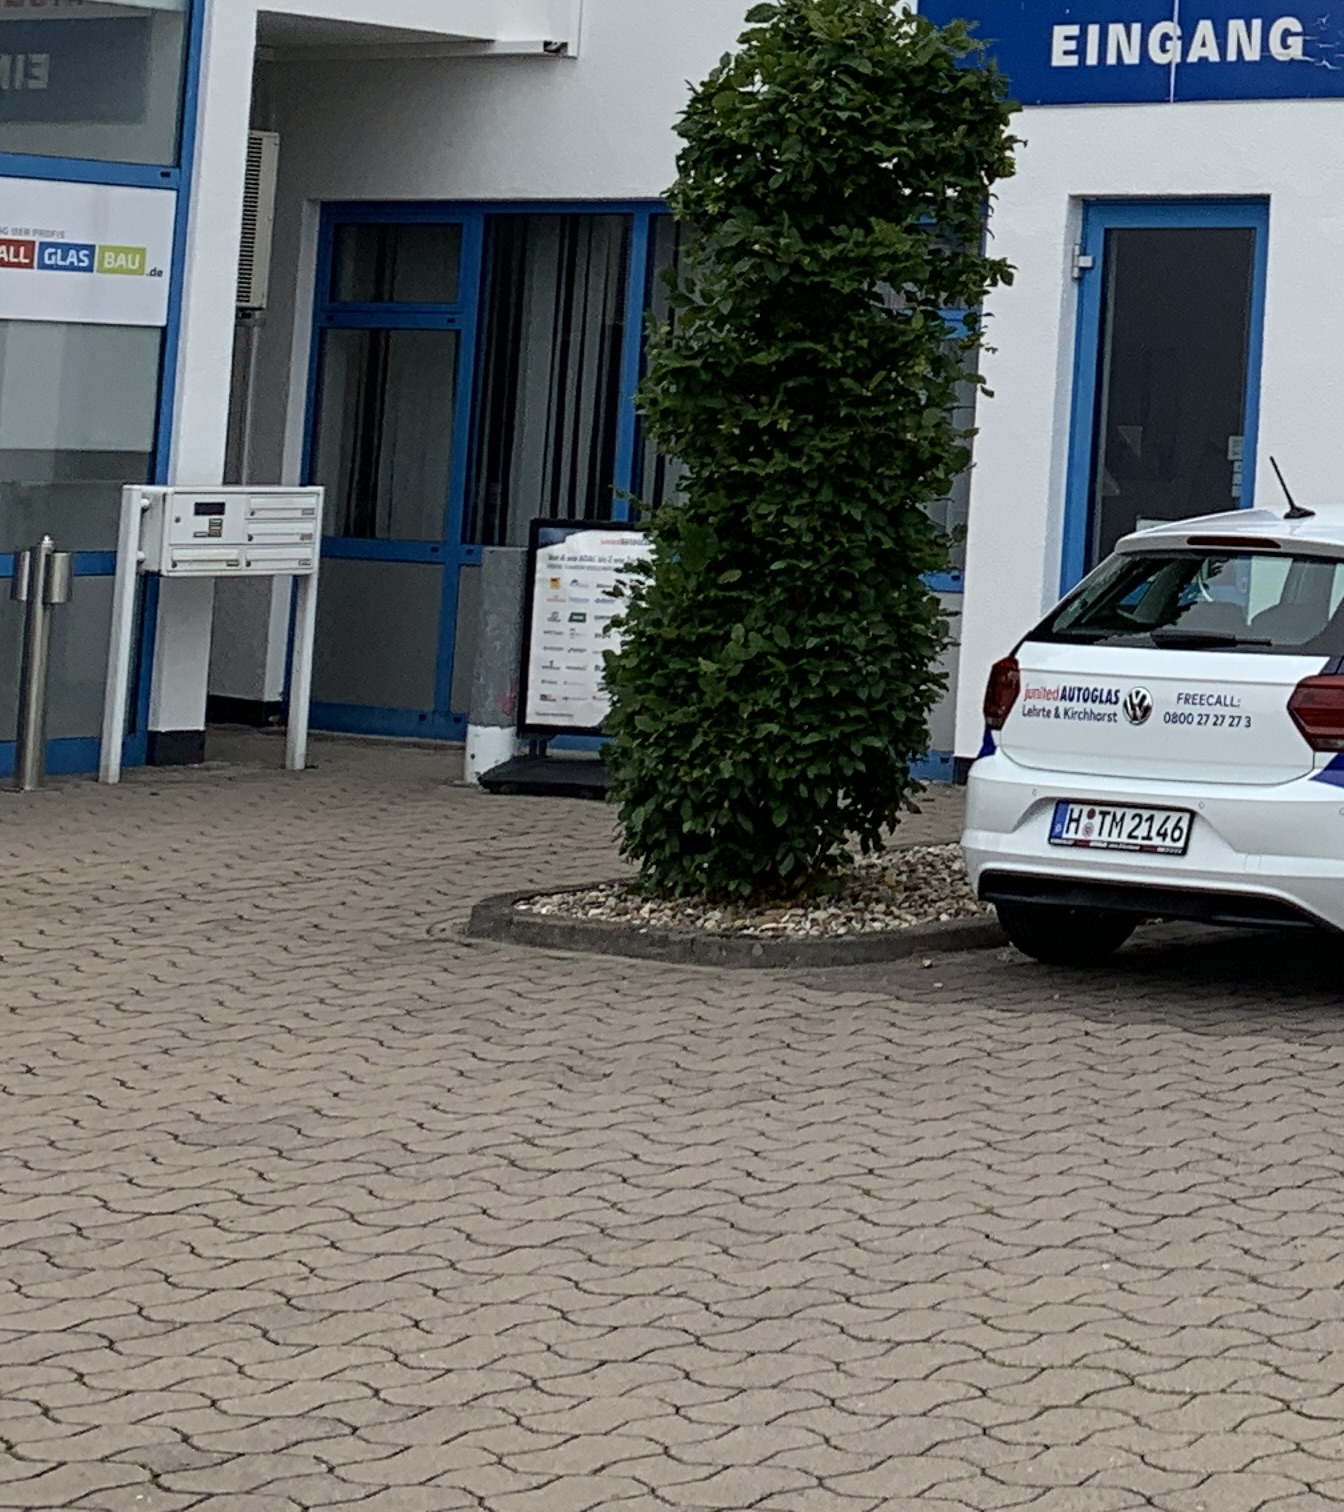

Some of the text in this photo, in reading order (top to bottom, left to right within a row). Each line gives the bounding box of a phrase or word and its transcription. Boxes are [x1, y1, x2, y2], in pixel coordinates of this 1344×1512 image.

[1050, 16, 1304, 67] EINGANG
[44, 248, 89, 267] GLAS
[104, 252, 139, 269] BAU
[1060, 686, 1120, 705] AUTOGLAS
[1177, 693, 1241, 707] FREECALL:
[1022, 705, 1118, 723] Lehrte & Kirchhorst
[1163, 712, 1251, 728] 0800 27 27 27 3
[1127, 813, 1183, 843] 2146
